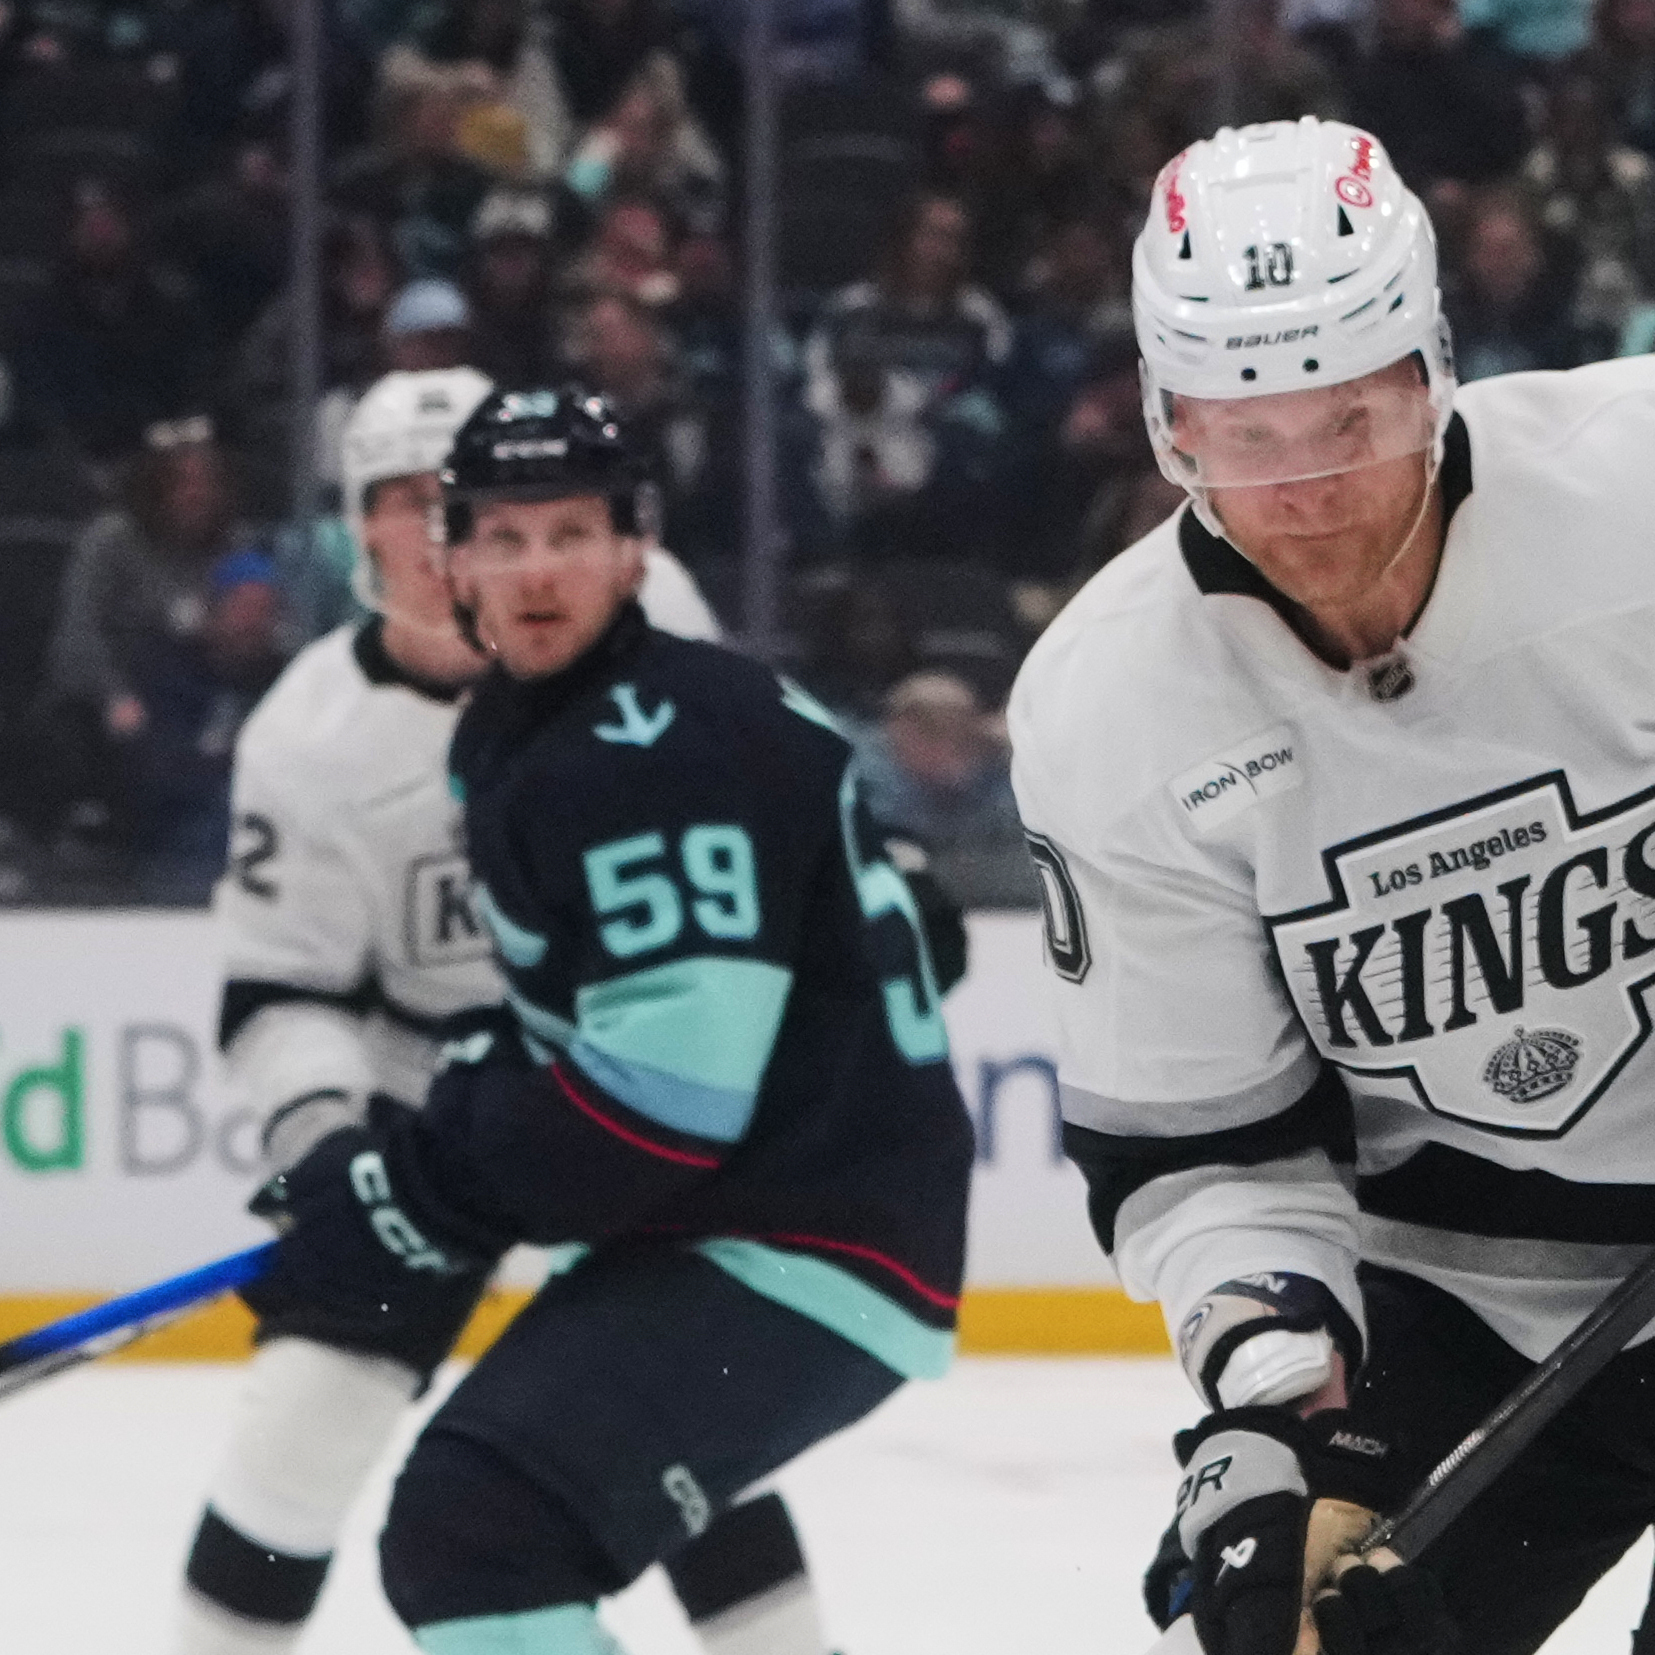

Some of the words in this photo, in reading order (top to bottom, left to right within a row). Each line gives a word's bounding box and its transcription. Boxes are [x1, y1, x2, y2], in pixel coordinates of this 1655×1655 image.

[1242, 242, 1294, 290] 10
[1226, 325, 1319, 349] BAUER
[1181, 770, 1236, 813] IRON
[1246, 745, 1296, 779] BOW
[582, 823, 760, 958] 59
[1369, 861, 1423, 899] Los
[1427, 818, 1547, 879] Angeles
